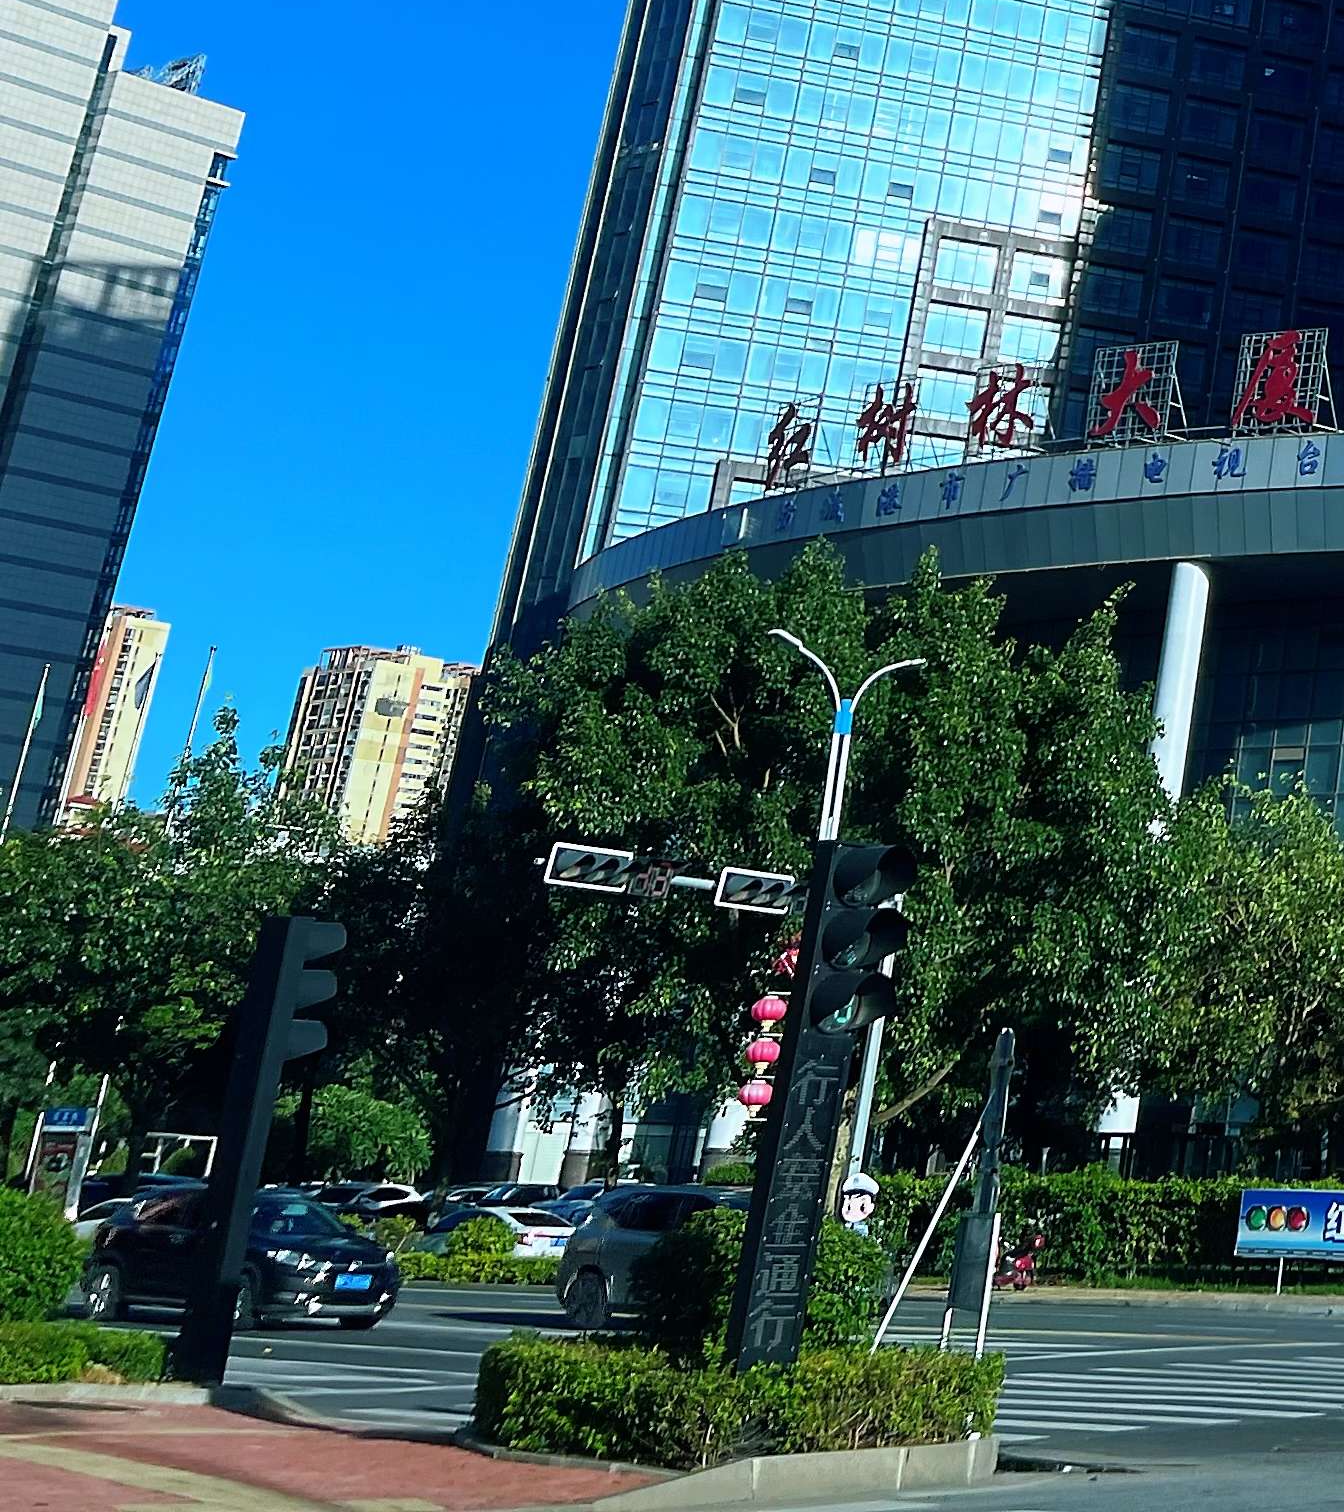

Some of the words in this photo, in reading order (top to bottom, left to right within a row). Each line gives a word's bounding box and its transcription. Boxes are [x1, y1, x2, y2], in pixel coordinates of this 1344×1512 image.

[765, 329, 1317, 489] 红树林大厦
